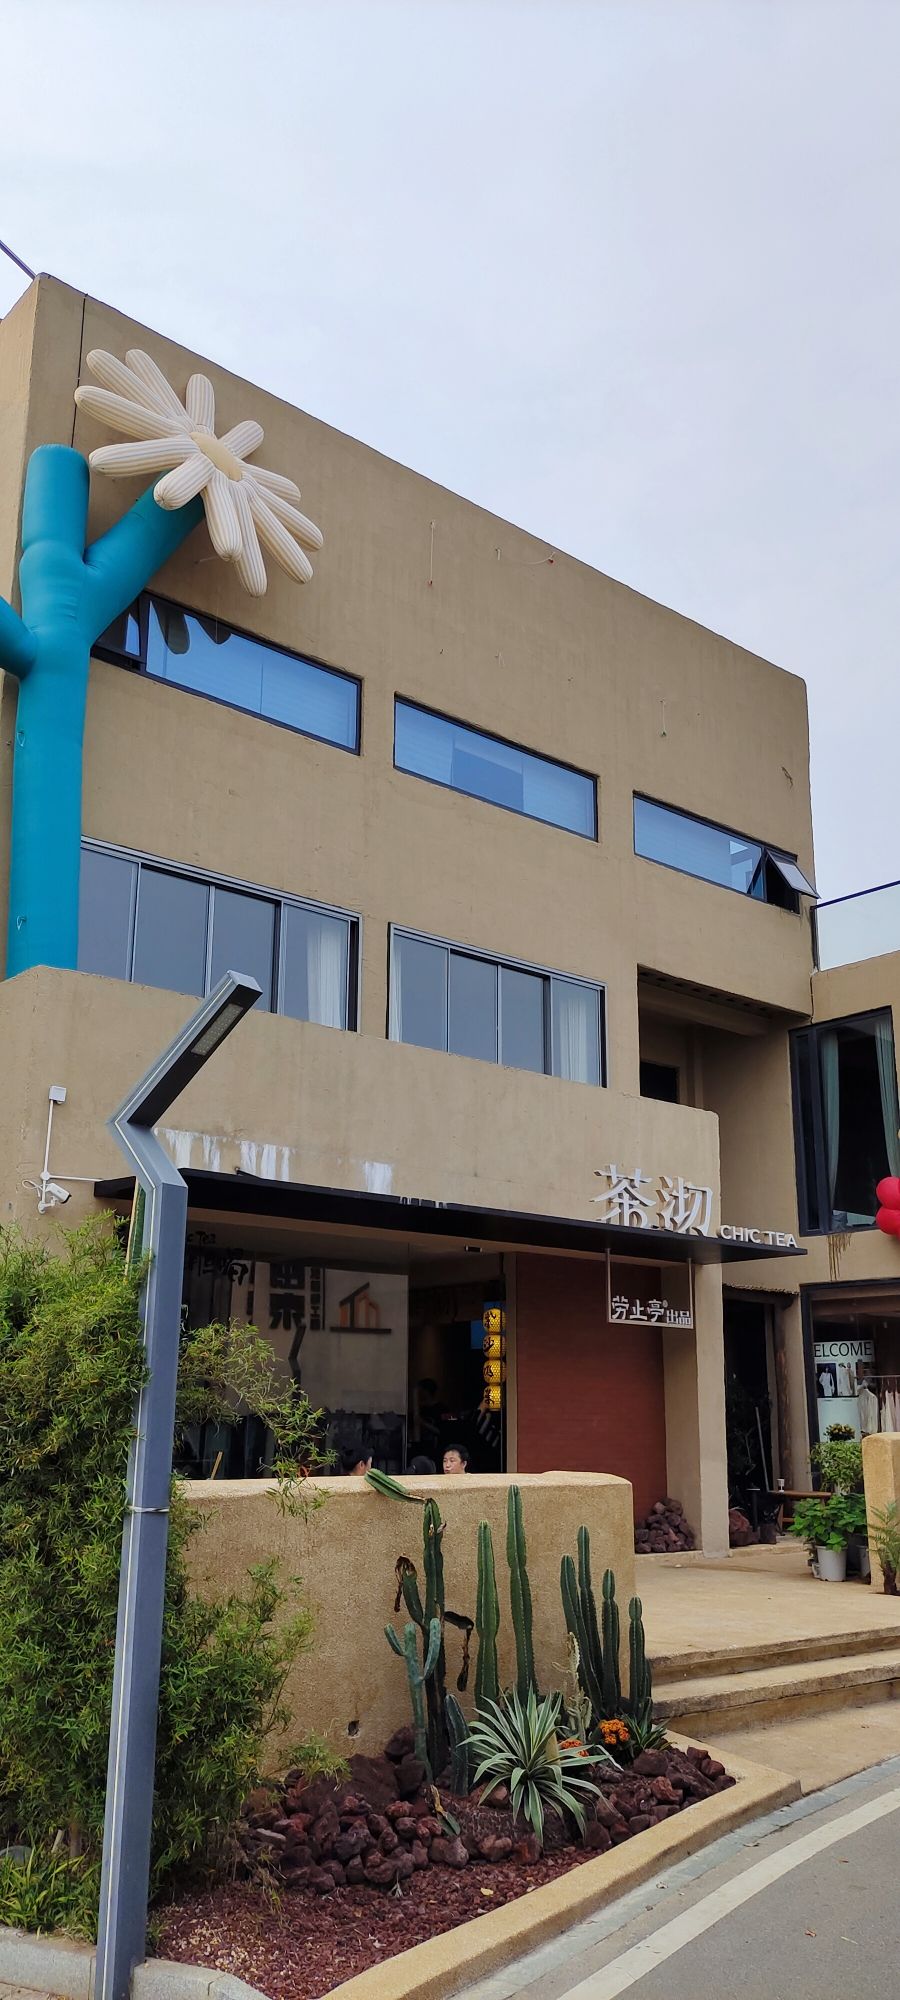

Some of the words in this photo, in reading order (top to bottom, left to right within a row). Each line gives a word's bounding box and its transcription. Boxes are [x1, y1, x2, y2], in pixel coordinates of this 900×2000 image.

[718, 1224, 761, 1244] CHIC
[765, 1230, 798, 1248] TEA
[814, 1341, 873, 1358] ELCOME
